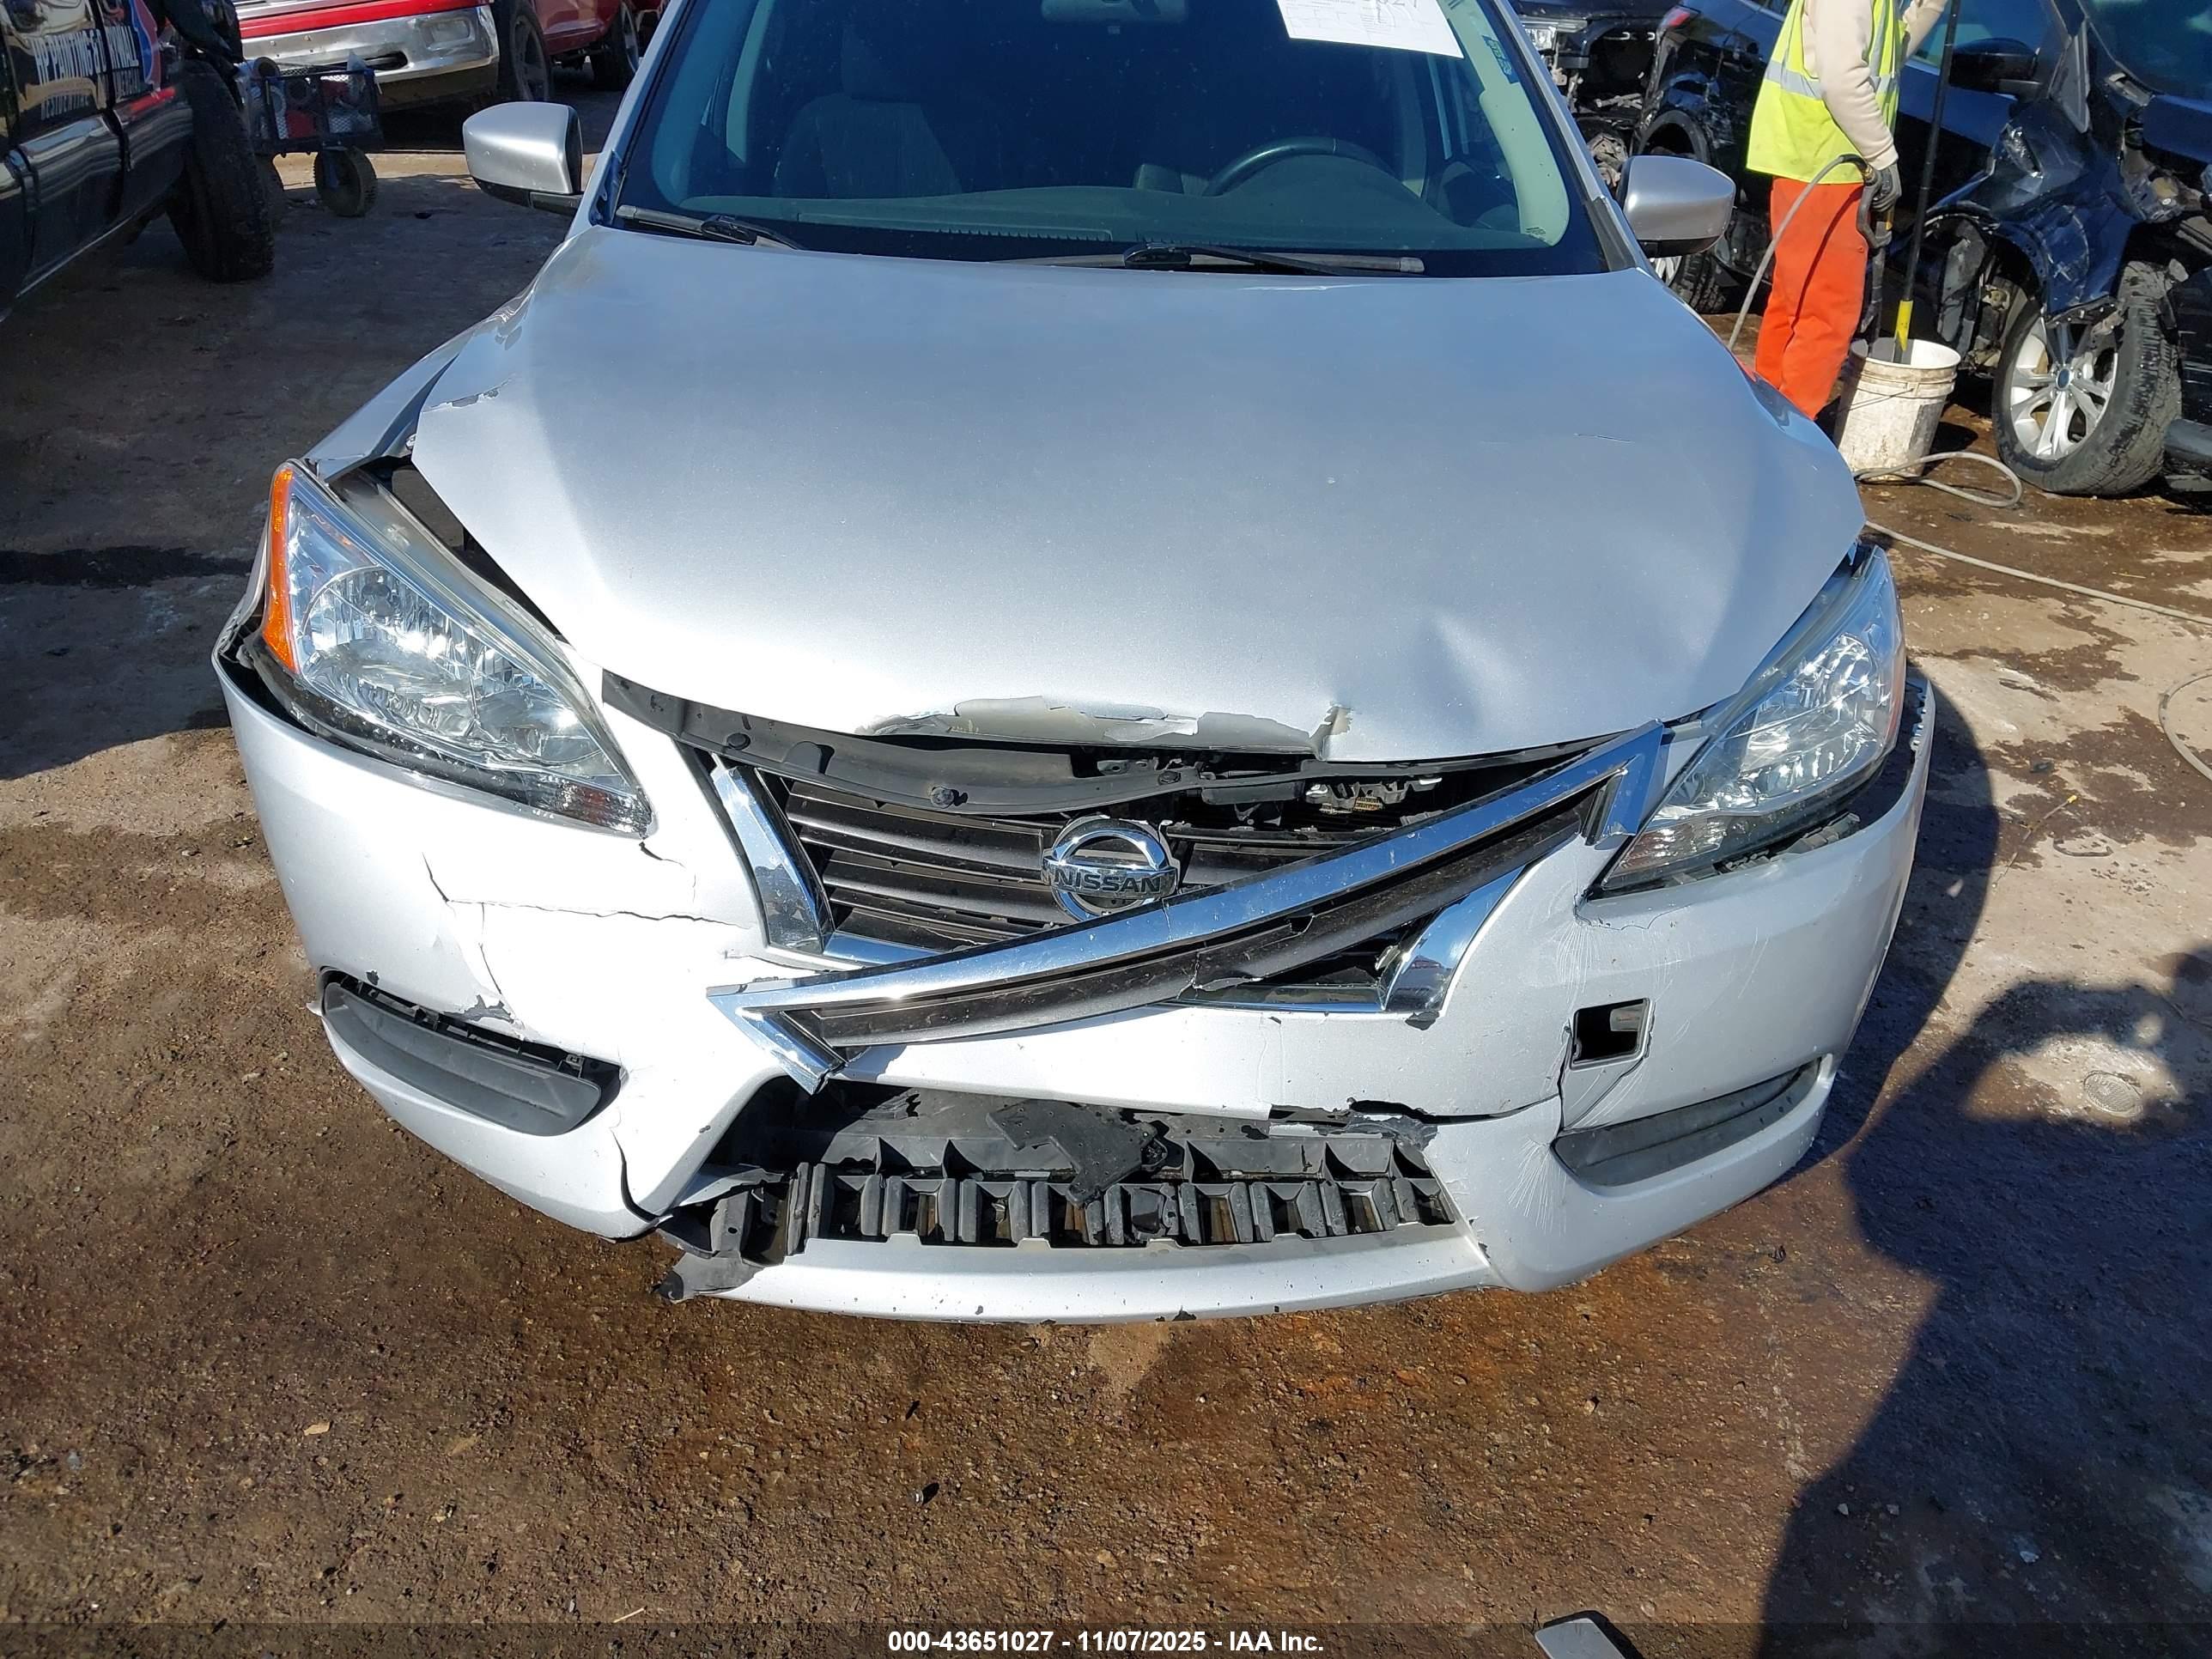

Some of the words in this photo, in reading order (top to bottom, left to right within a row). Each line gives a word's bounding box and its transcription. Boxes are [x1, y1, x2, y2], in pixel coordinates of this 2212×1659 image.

[45, 30, 94, 83] PAINTING
[89, 28, 101, 74] &
[1054, 867, 1162, 894] NISSAN
